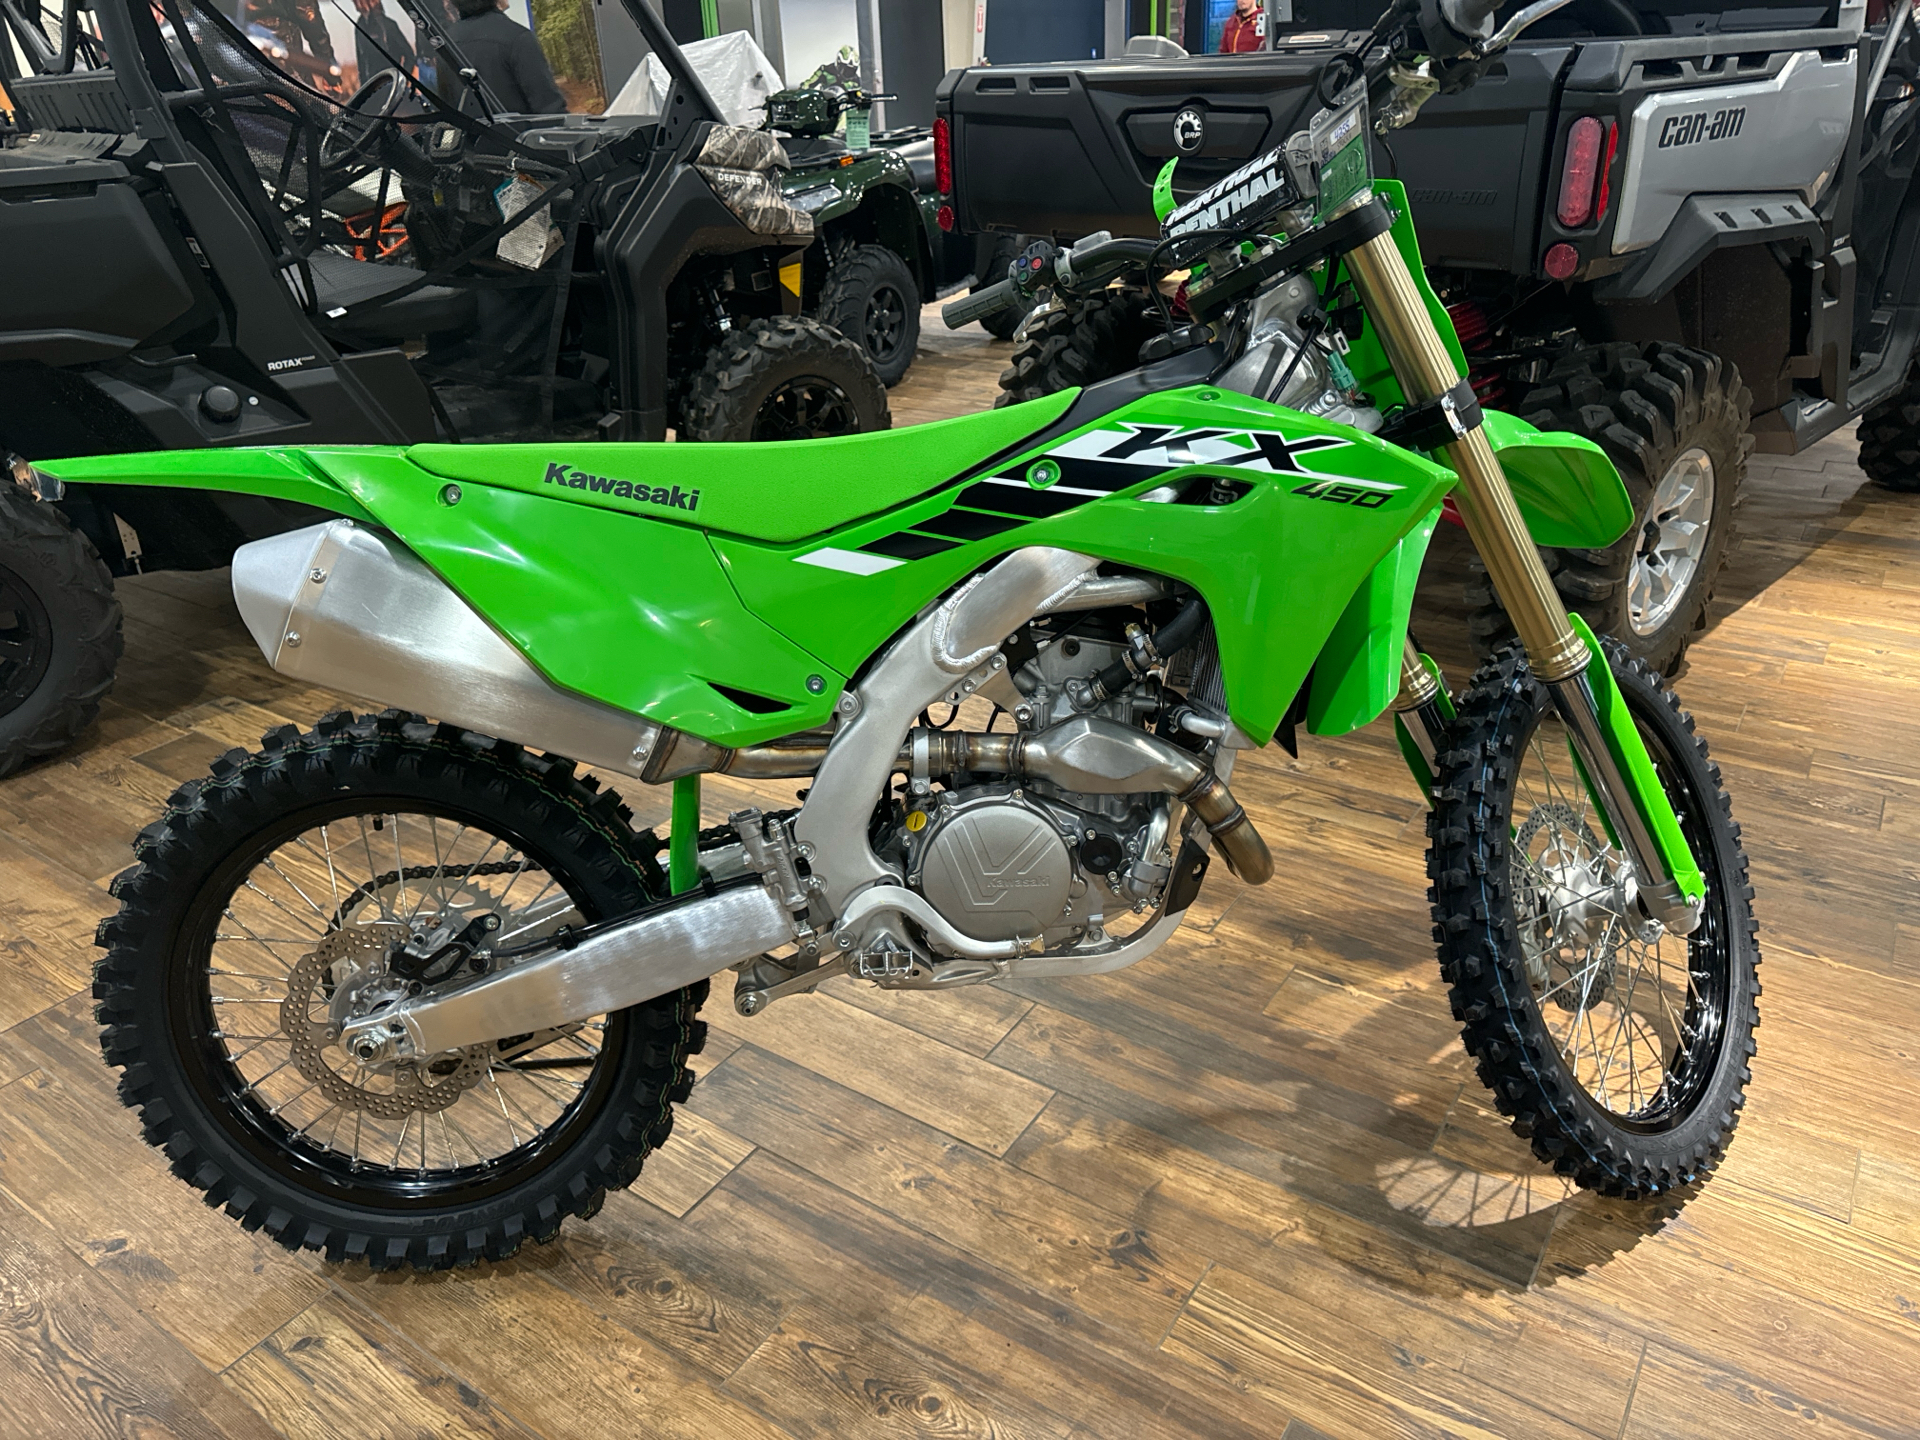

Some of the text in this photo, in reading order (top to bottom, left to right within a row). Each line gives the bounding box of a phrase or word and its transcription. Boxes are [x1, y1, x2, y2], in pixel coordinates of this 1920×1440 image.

[1184, 131, 1201, 139] BRP
[717, 172, 763, 186] DEFENDER
[1166, 150, 1279, 225] RENTHAL
[1170, 168, 1285, 248] RENTHAL
[267, 357, 303, 371] ROTAX
[1096, 426, 1349, 474] KX
[544, 462, 700, 511] Kawasaki
[1292, 482, 1395, 508] 450
[986, 875, 1051, 888] Kawasaki
